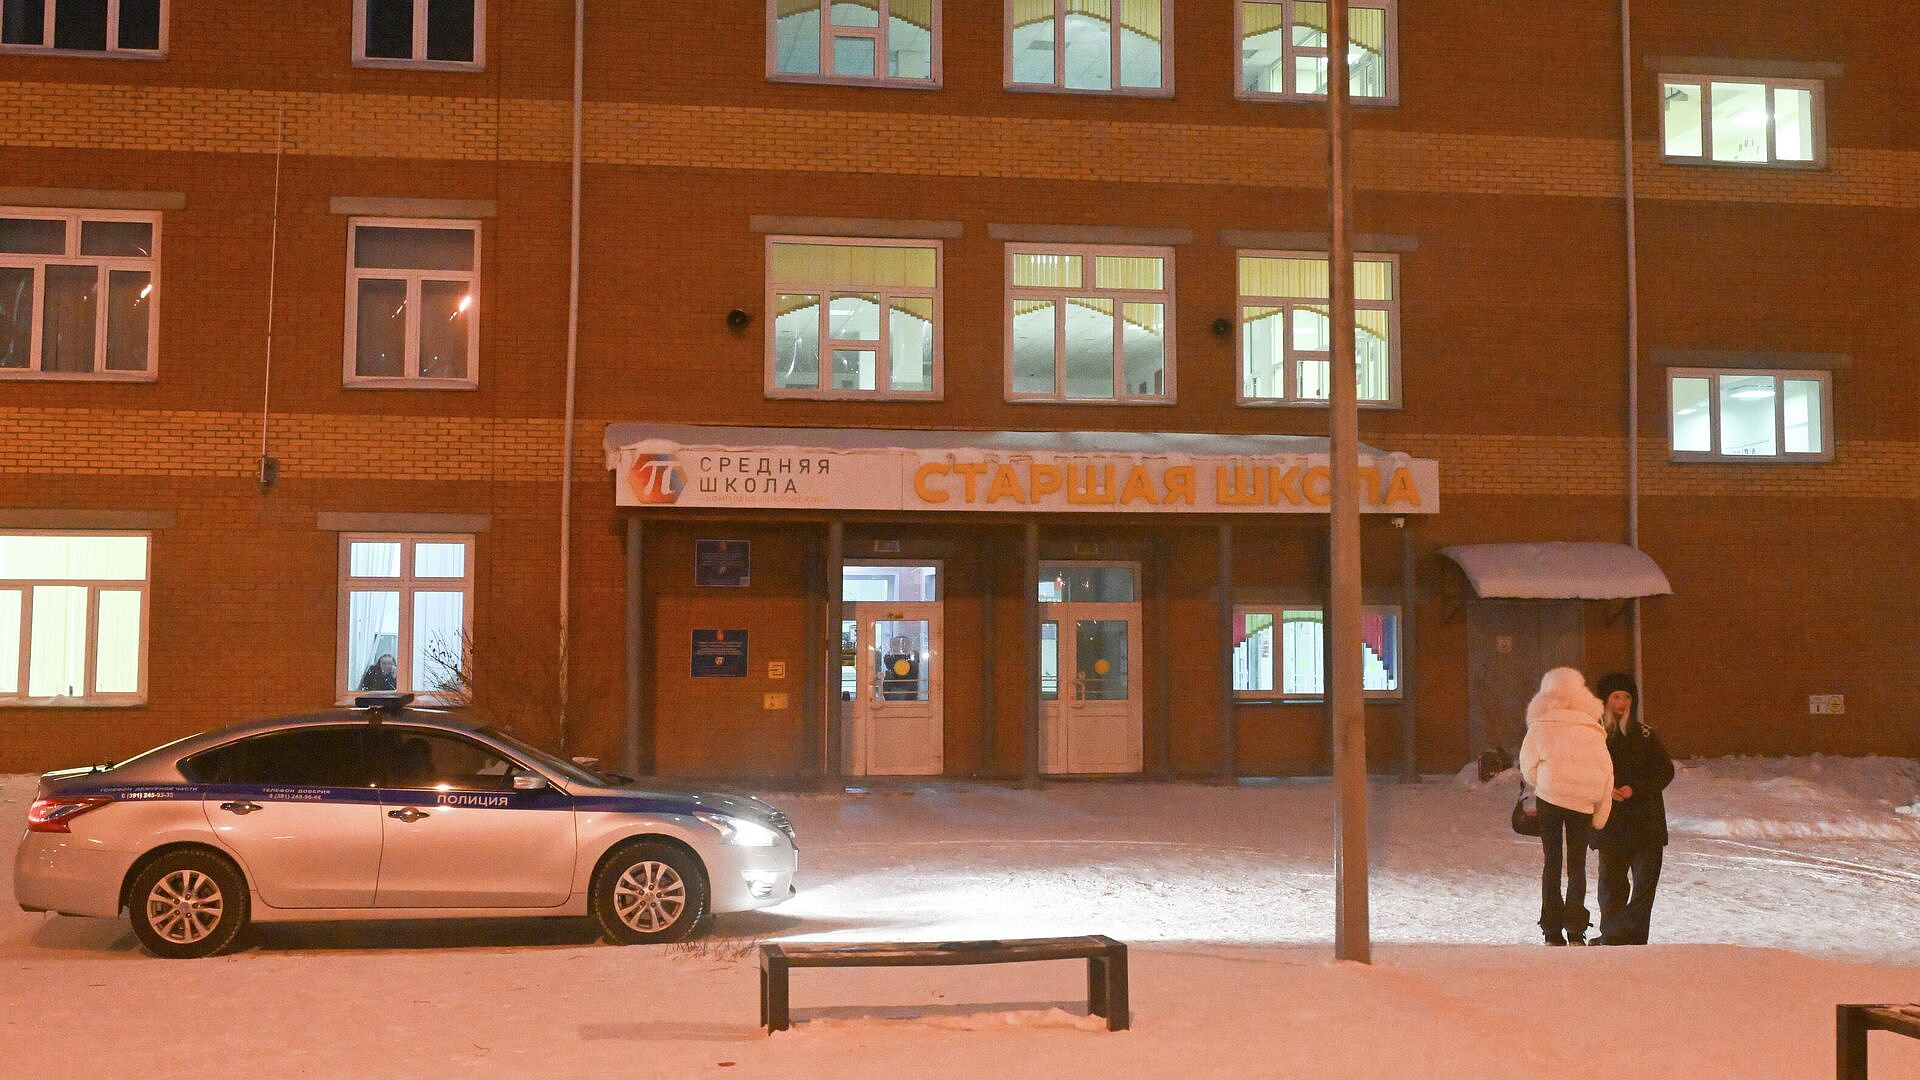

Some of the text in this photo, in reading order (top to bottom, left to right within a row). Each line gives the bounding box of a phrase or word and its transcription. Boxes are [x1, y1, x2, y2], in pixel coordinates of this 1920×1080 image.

[700, 456, 830, 476] СРЕДНЯЯ
[700, 477, 798, 494] ШКОЛА
[914, 462, 1197, 505] СТАРШАЯ
[436, 794, 508, 807] ПОЛИЦИЯ
